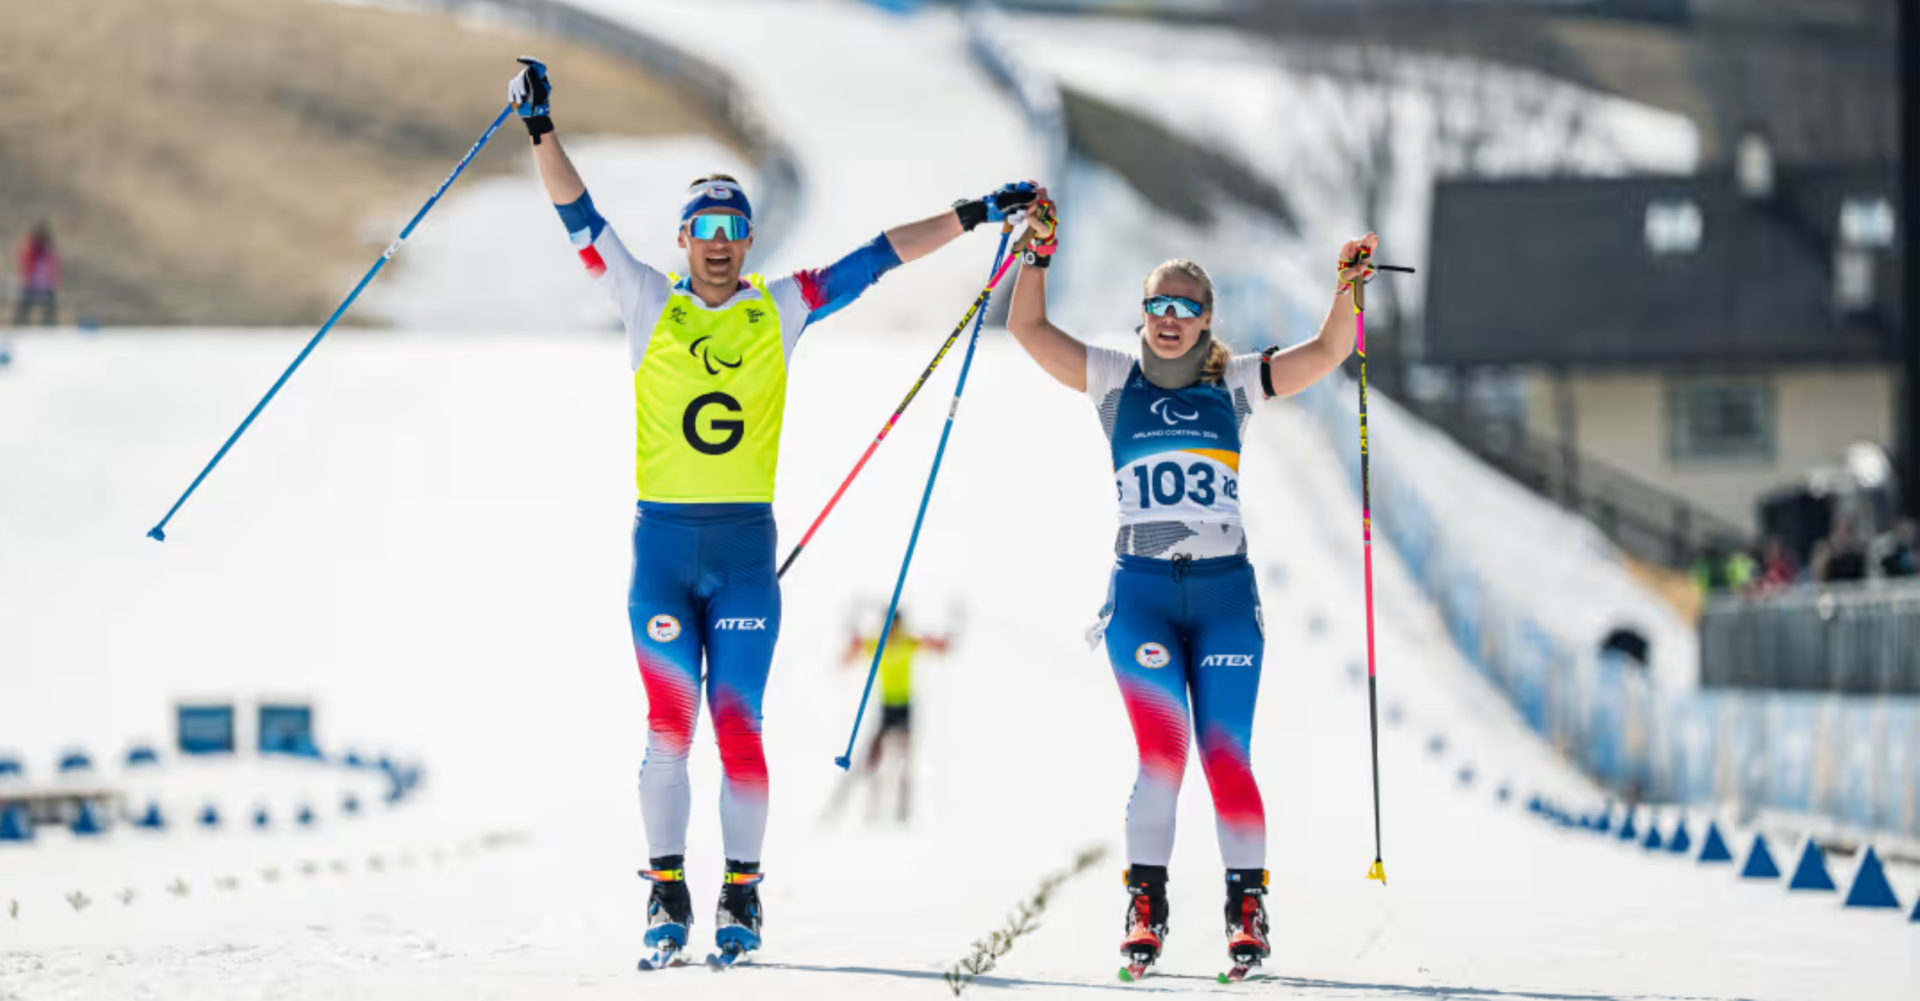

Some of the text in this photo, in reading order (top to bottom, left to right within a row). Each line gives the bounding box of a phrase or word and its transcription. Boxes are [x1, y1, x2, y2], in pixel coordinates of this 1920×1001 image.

[682, 391, 744, 455] G
[1132, 429, 1164, 440] MILANO
[1164, 428, 1201, 437] CORTINA
[1359, 413, 1367, 455] LEKI
[1133, 461, 1216, 509] 103
[714, 617, 767, 631] ATEX
[1201, 654, 1254, 667] ATEX
